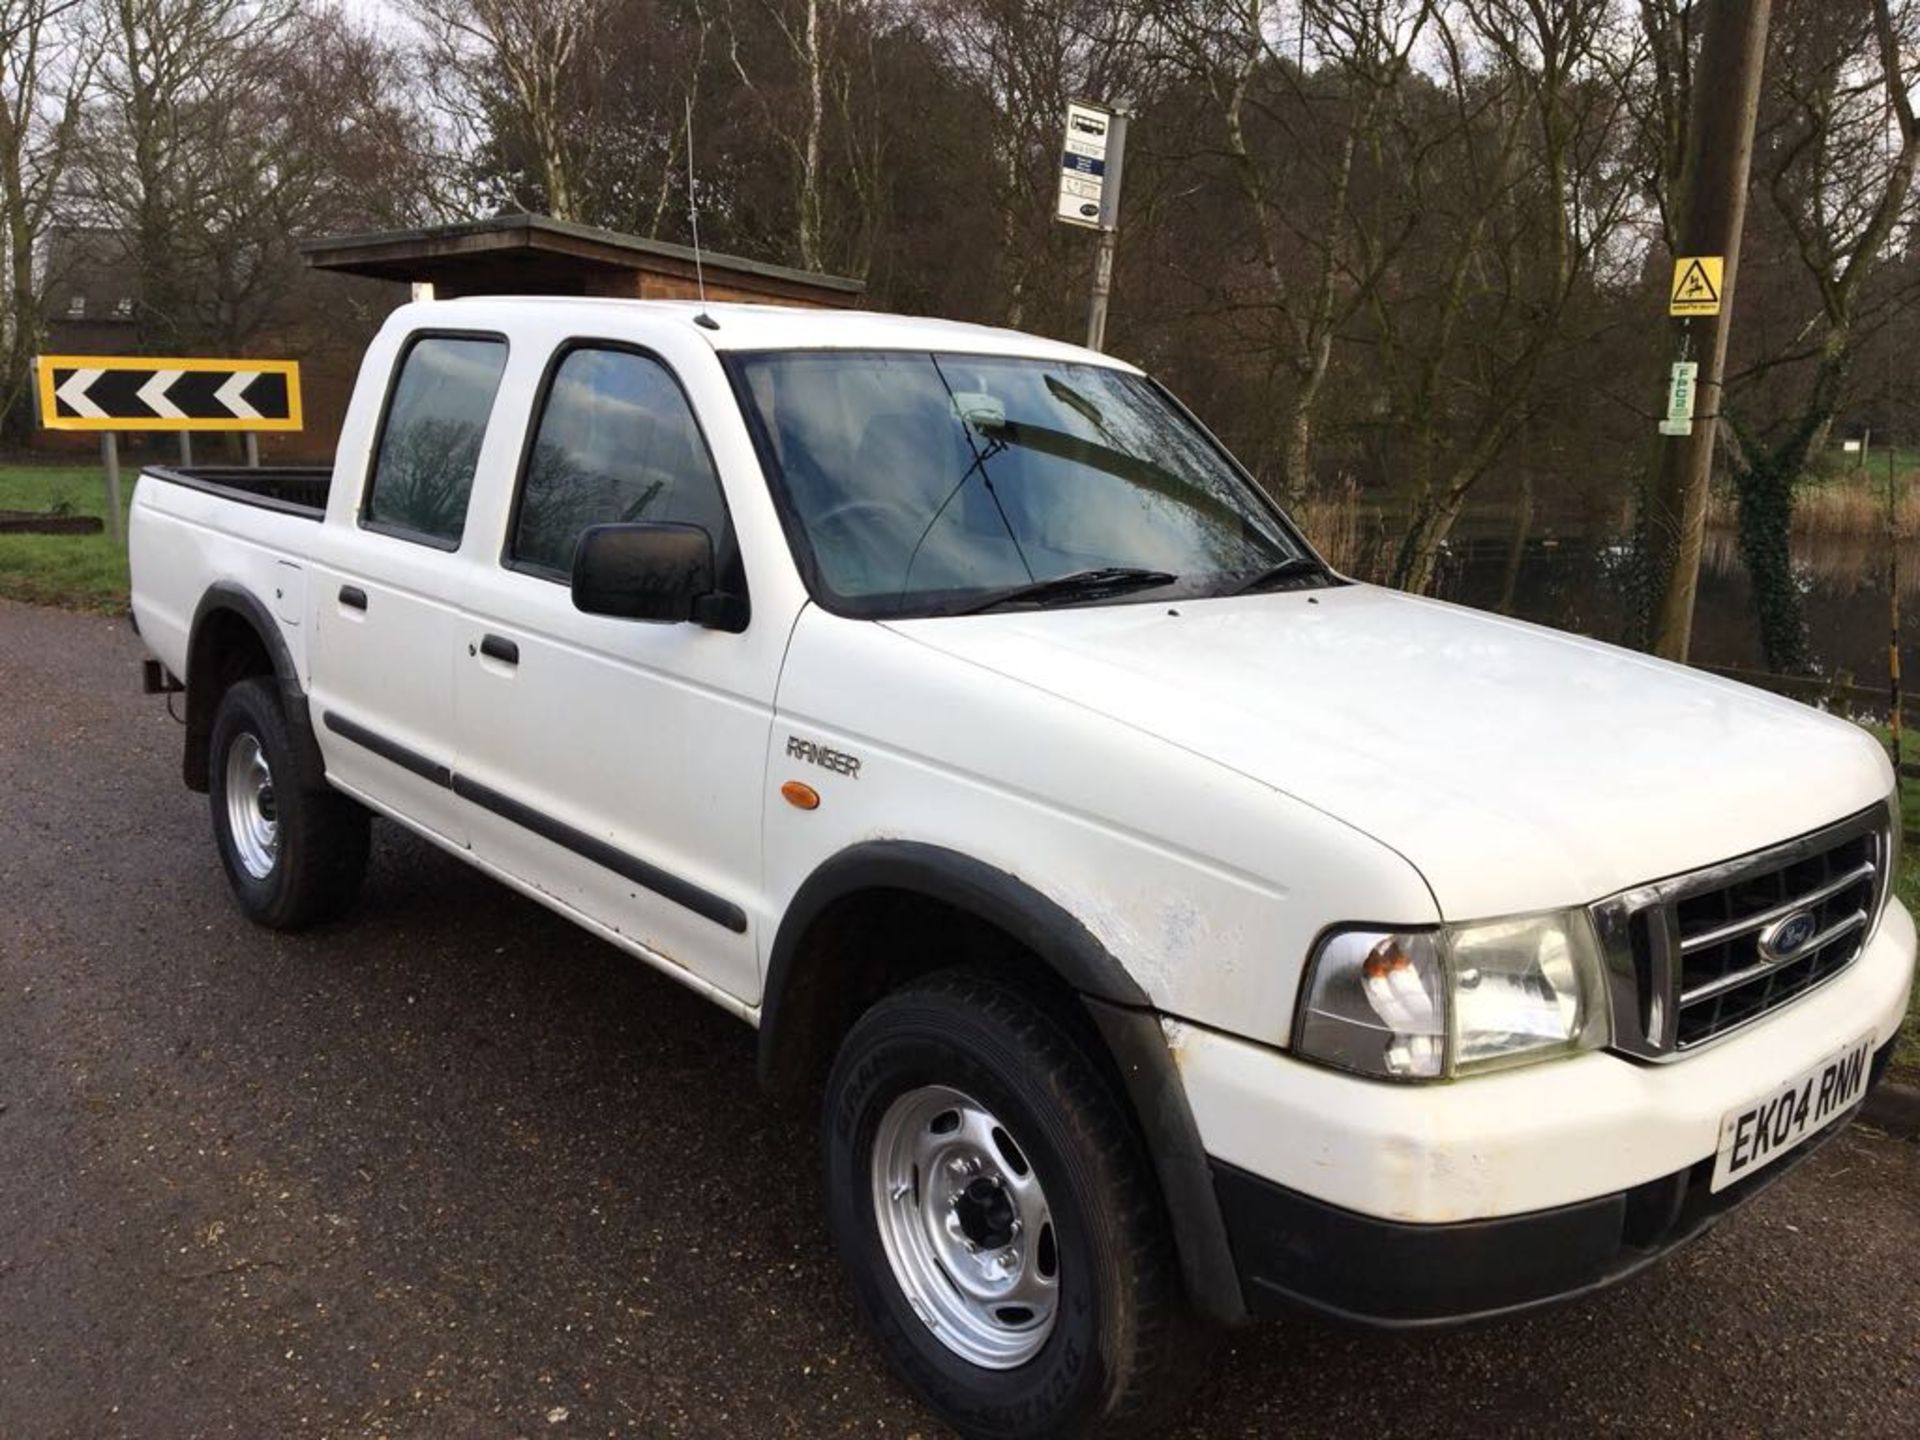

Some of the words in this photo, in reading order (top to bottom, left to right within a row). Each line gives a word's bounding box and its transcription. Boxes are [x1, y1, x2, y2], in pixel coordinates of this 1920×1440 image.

[786, 735, 862, 780] RANGER
[1729, 1078, 1813, 1173] EK04
[1815, 1042, 1869, 1122] RNN
